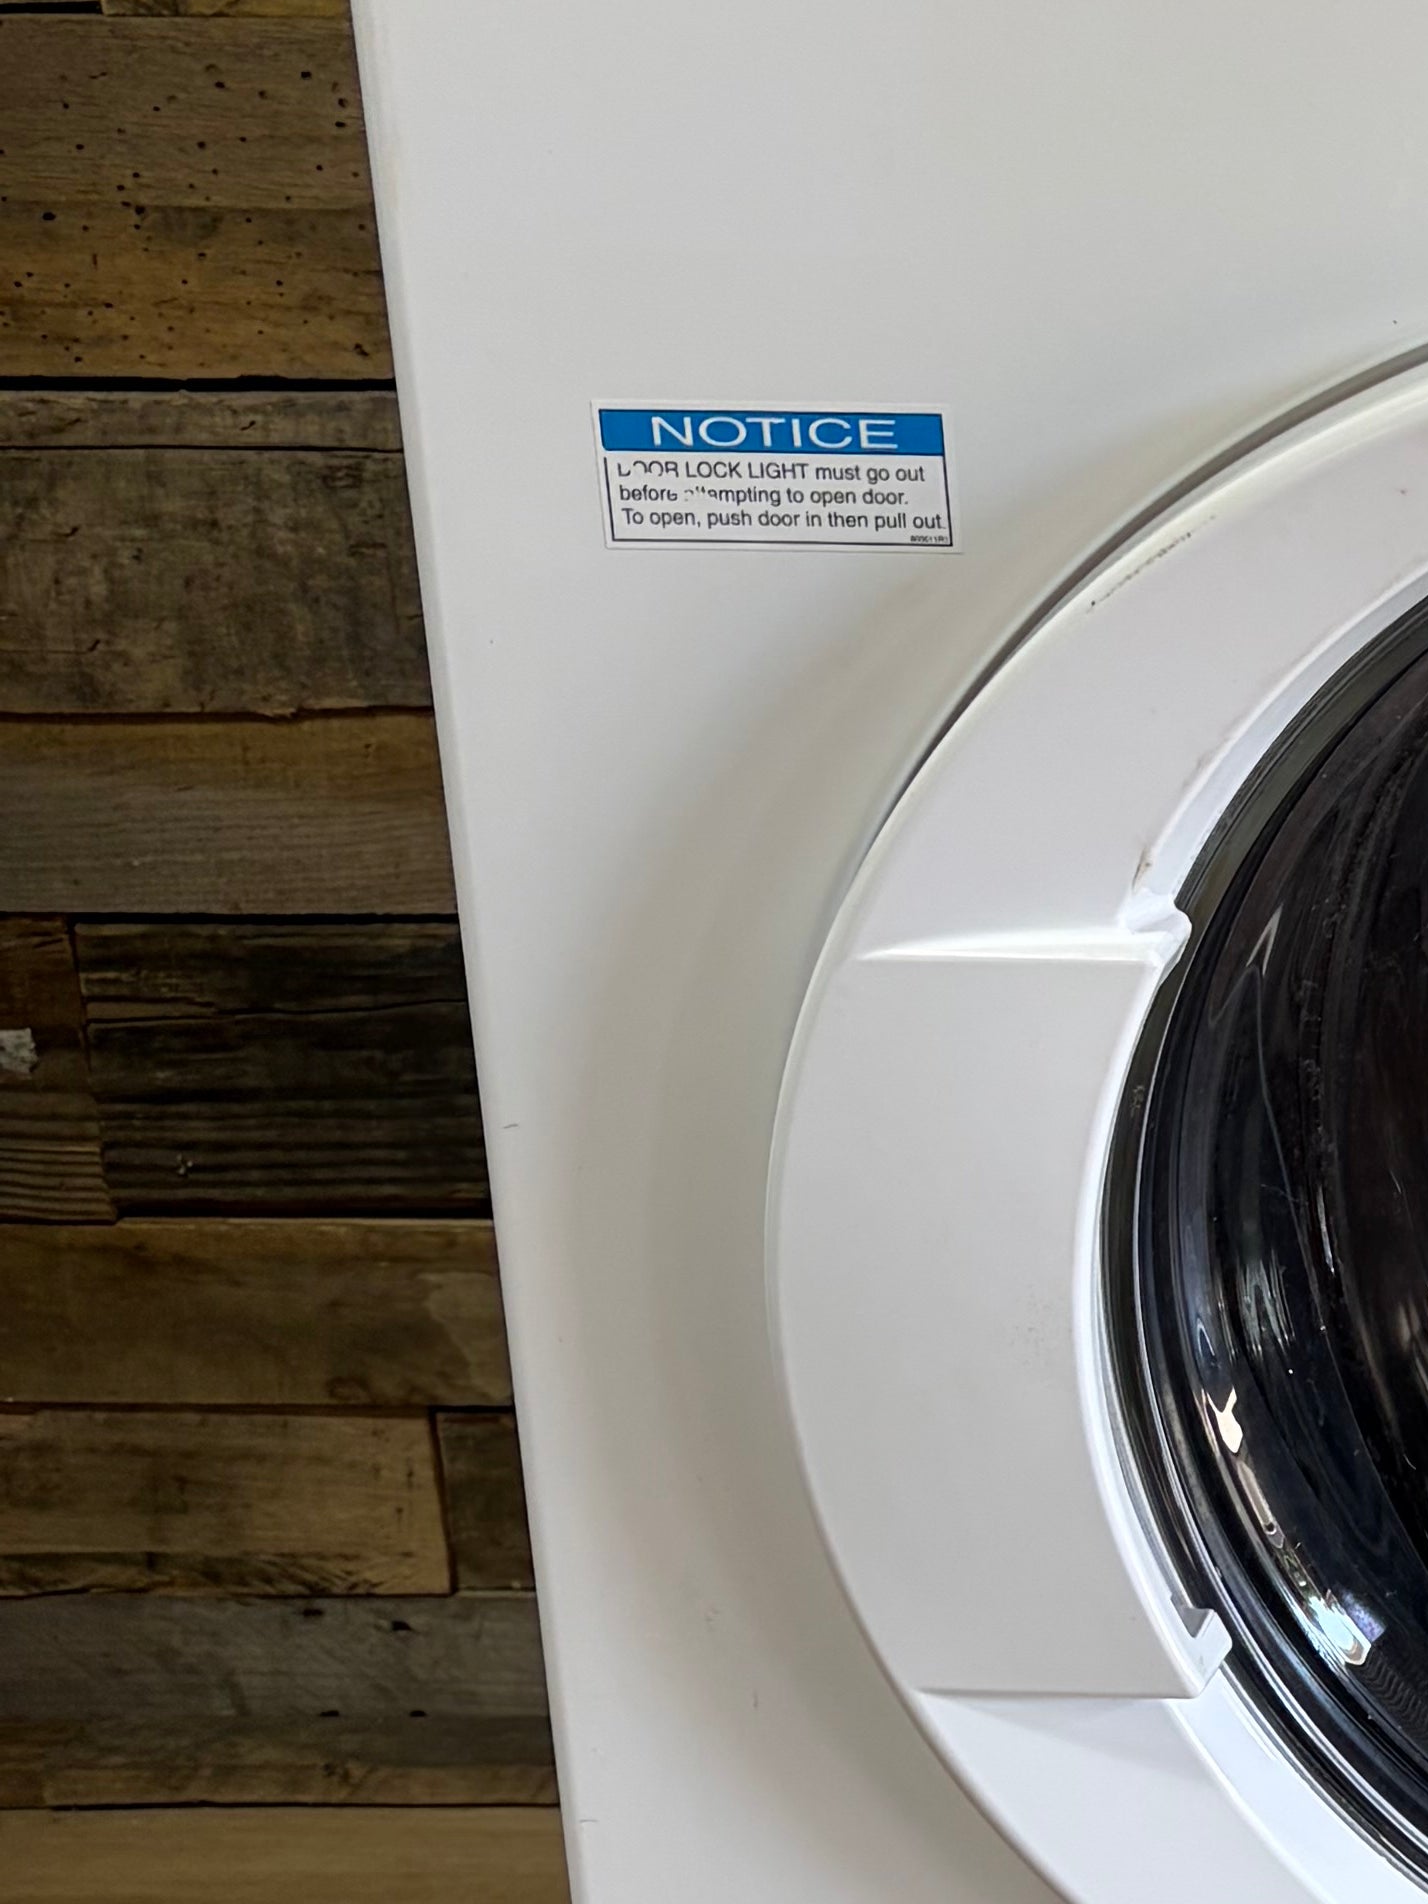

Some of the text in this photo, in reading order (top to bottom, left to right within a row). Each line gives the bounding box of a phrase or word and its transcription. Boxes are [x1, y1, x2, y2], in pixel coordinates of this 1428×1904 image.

[651, 416, 898, 449] NOTICE
[685, 460, 743, 479] LOCK
[747, 461, 810, 480] LIGHT
[815, 464, 862, 481] must
[866, 467, 891, 486] go
[895, 465, 926, 482] out
[785, 487, 805, 504] to
[809, 490, 857, 508] open
[861, 488, 909, 506] door.
[620, 507, 645, 525] To
[649, 511, 701, 529] open,
[706, 509, 753, 530] push
[757, 509, 801, 527] door
[805, 510, 823, 527] in
[827, 511, 869, 528] then
[874, 512, 907, 532] pull
